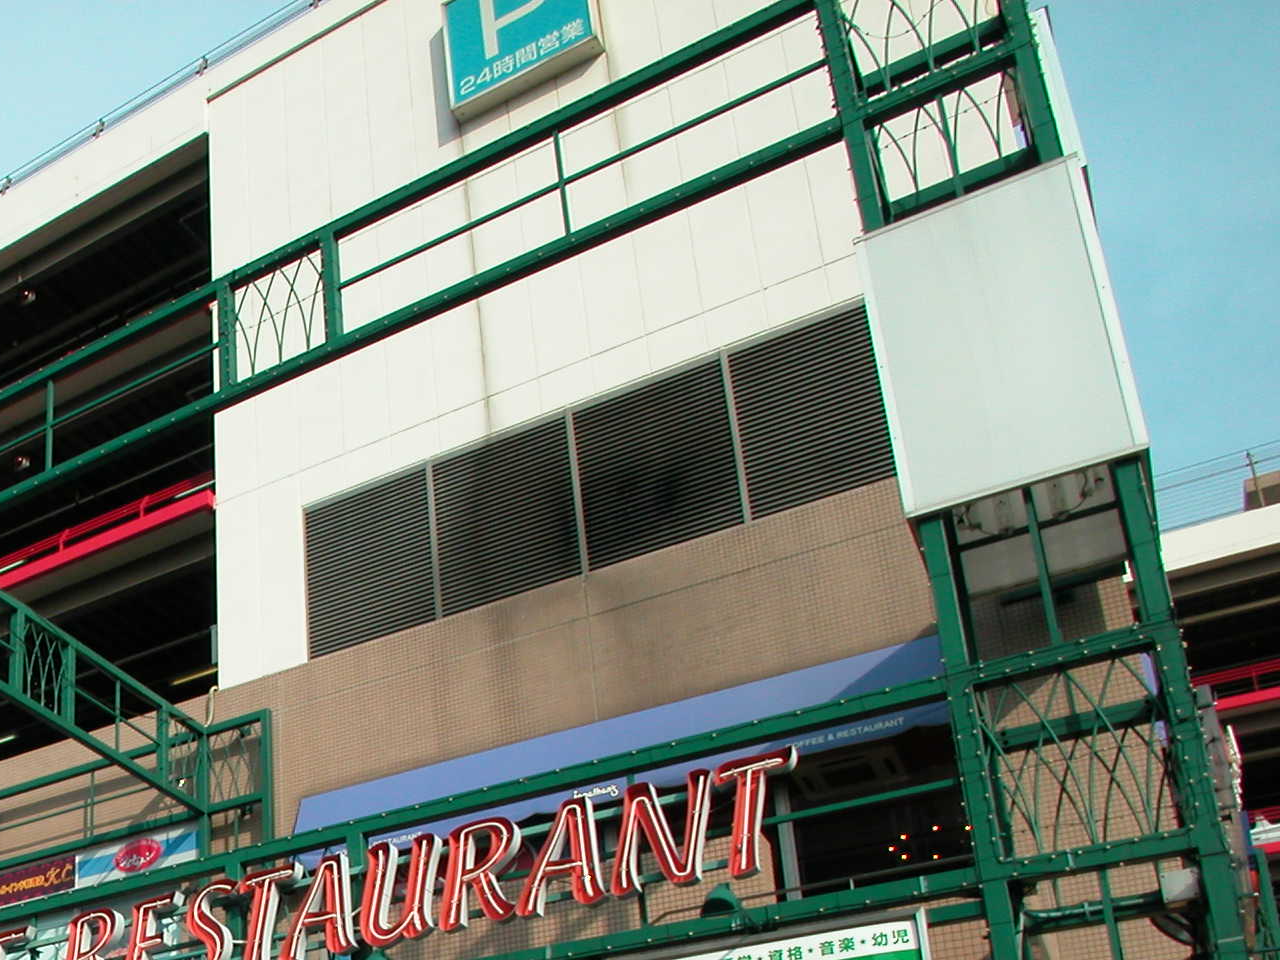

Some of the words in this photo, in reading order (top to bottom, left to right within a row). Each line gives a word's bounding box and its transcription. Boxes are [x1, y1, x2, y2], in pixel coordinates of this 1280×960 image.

[459, 18, 585, 95] 24時間営業
[836, 716, 905, 740] RESTAURANT
